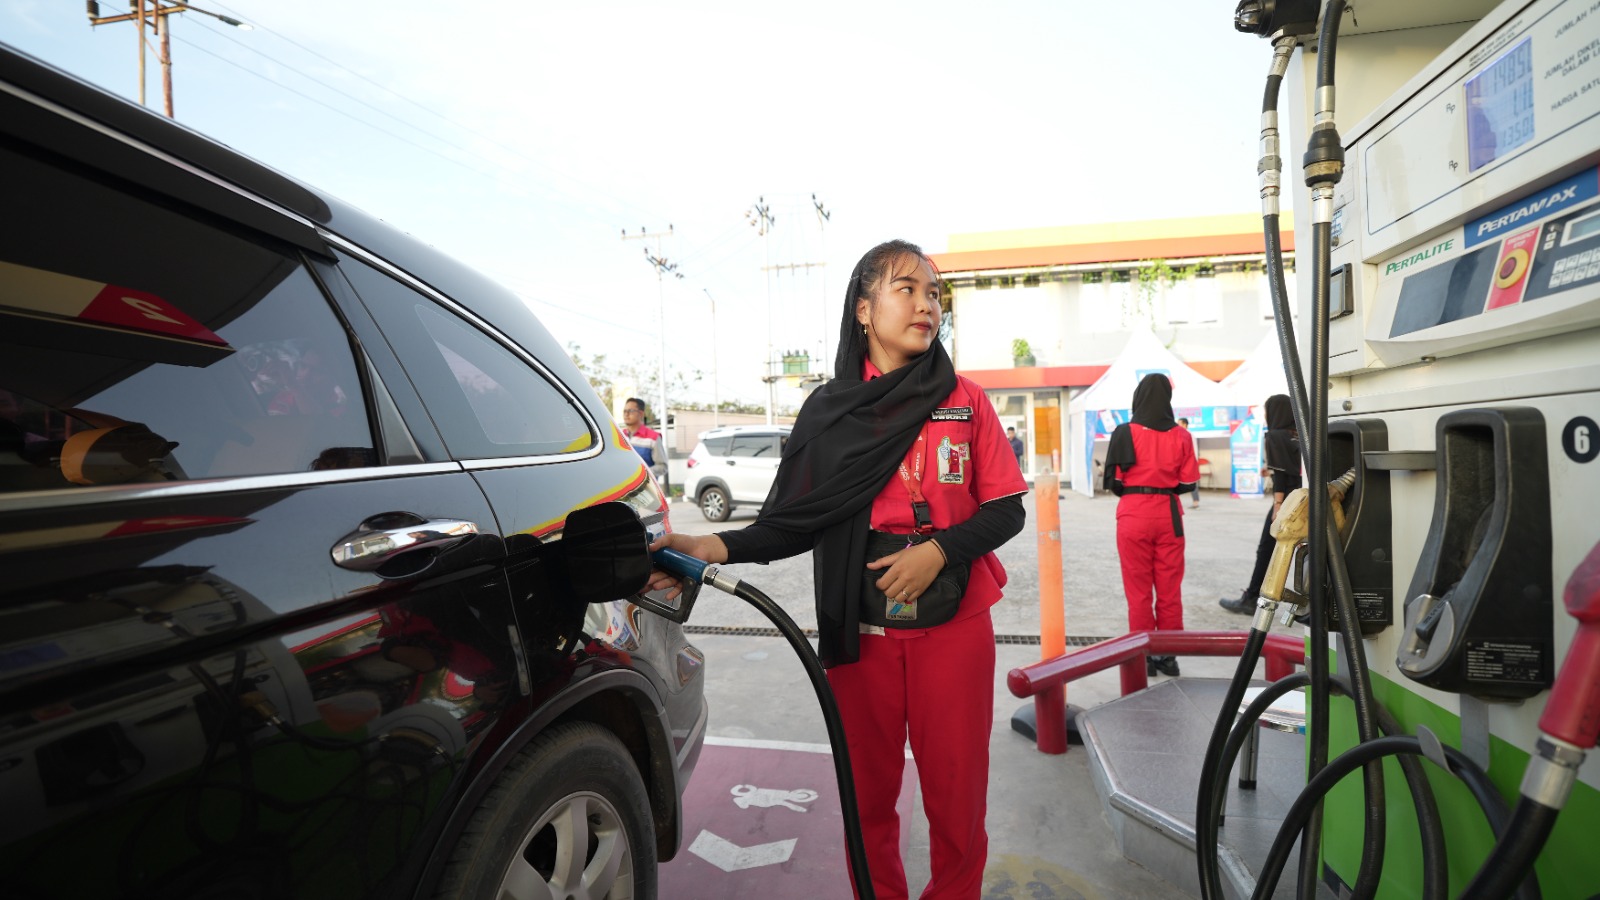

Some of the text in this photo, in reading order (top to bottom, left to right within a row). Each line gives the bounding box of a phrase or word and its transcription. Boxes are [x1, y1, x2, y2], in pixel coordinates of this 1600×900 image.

[1554, 11, 1588, 38] JUMLAH
[1544, 55, 1575, 80] JUMLAH
[1561, 54, 1590, 77] DALAM
[1446, 103, 1456, 114] Rp
[1550, 91, 1578, 112] HARGA
[1449, 160, 1459, 172] Rp
[1477, 185, 1578, 237] PERTAMAX
[1385, 238, 1455, 276] PERTALITE
[1573, 425, 1591, 454] 6
